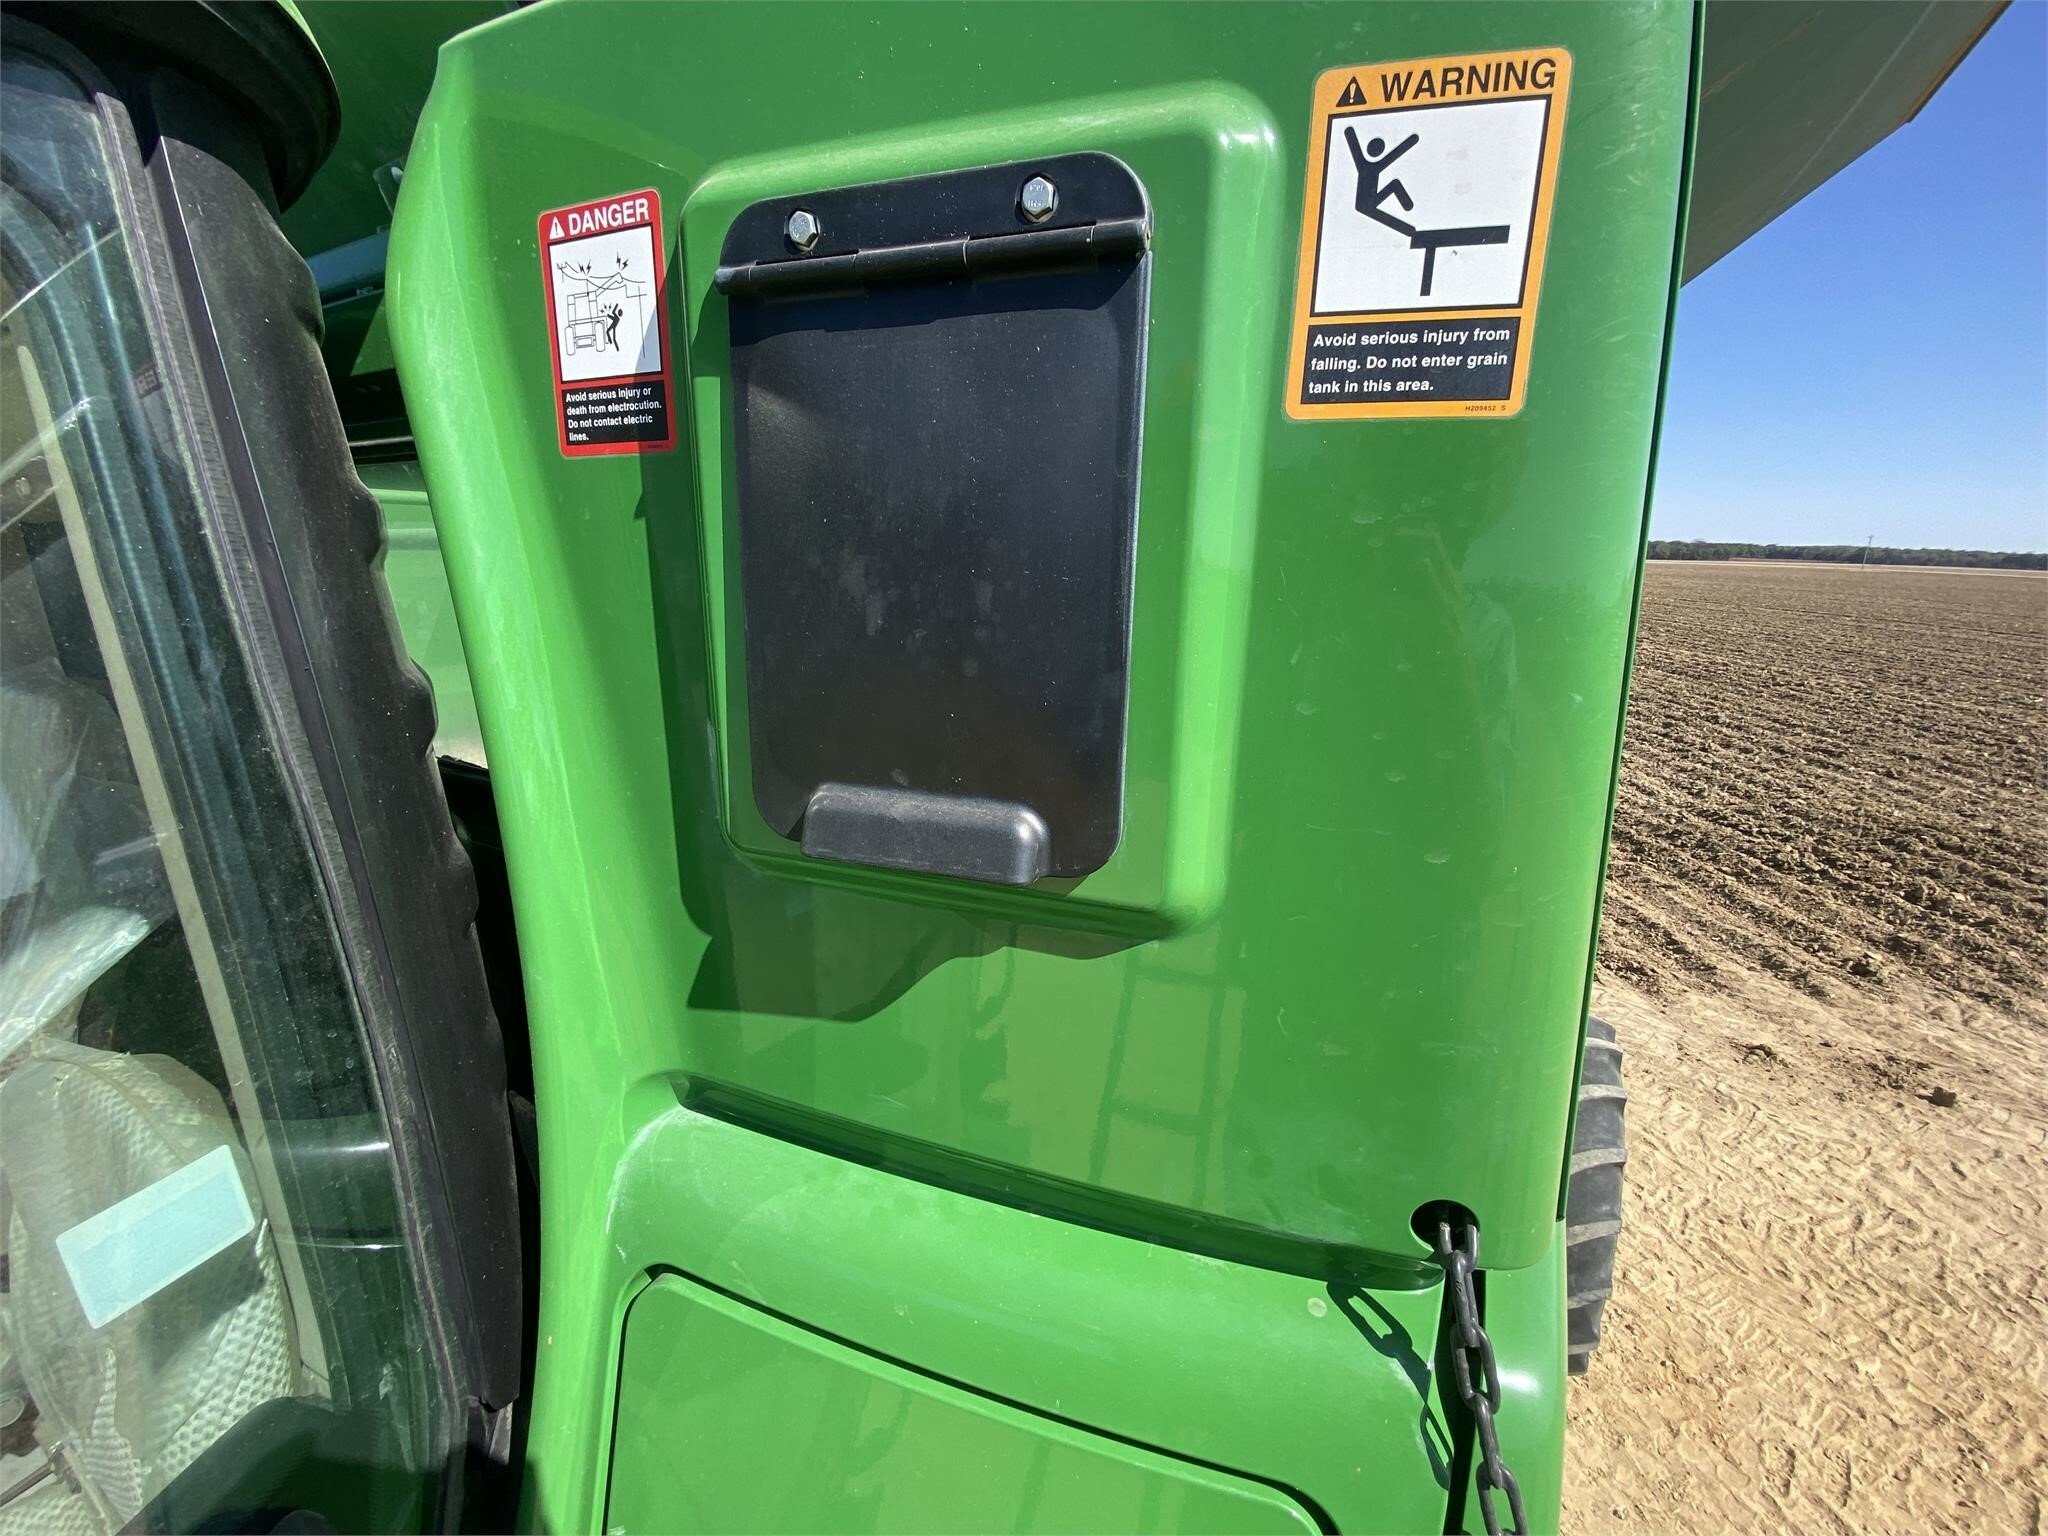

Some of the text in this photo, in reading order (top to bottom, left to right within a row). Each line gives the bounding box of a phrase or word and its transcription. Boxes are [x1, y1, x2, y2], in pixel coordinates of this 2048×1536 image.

[1381, 58, 1556, 102] WARNING
[568, 198, 649, 235] DANGER
[1313, 328, 1510, 347] Avoid serious injury from
[1311, 352, 1507, 373] falling. Do not enter grain
[566, 387, 651, 402] Avoid serious injury or
[1309, 379, 1434, 394] tank in this area.
[567, 400, 662, 416] death from electrocution.
[568, 413, 653, 429] Do not contact electric
[569, 432, 589, 441] lines.
